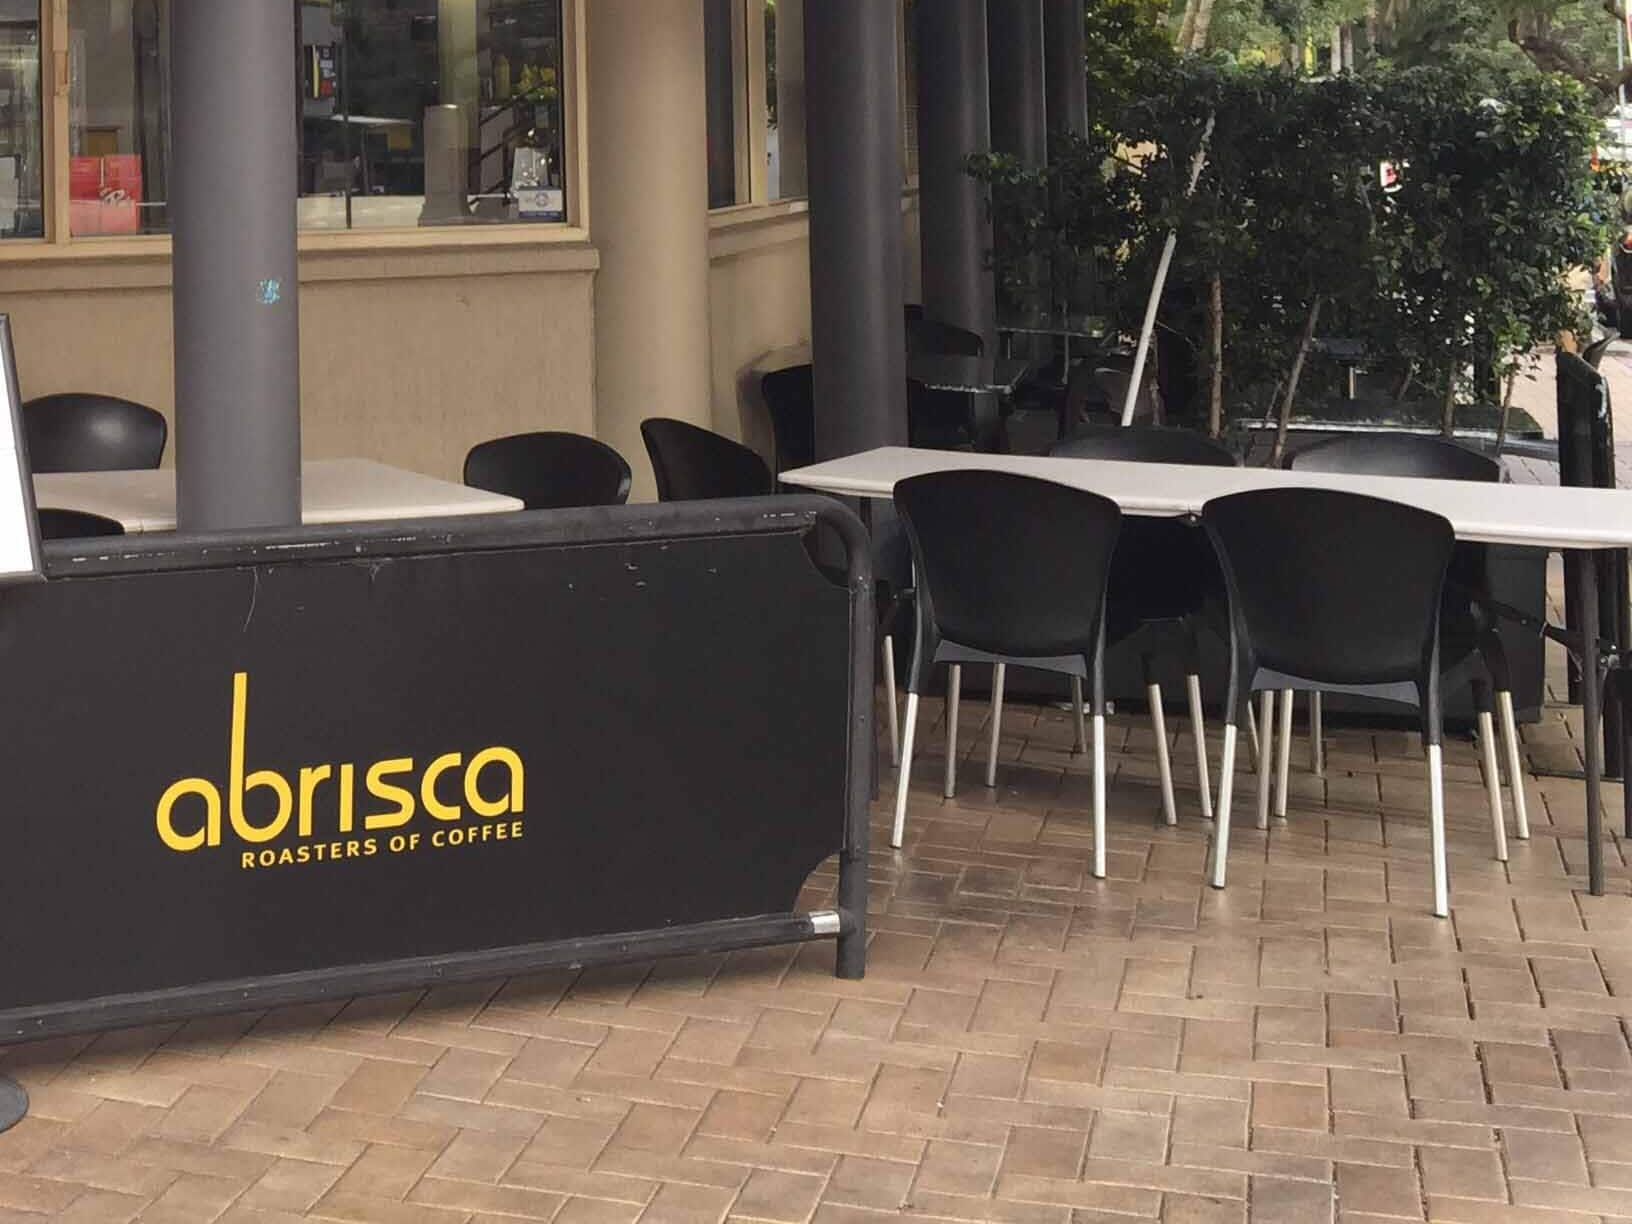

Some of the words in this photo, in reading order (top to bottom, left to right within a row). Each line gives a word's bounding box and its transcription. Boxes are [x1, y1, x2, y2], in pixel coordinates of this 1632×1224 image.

[156, 671, 525, 852] abrisca
[241, 838, 378, 869] ROASTERS
[389, 833, 422, 853] OF
[431, 821, 524, 849] COFFEE
